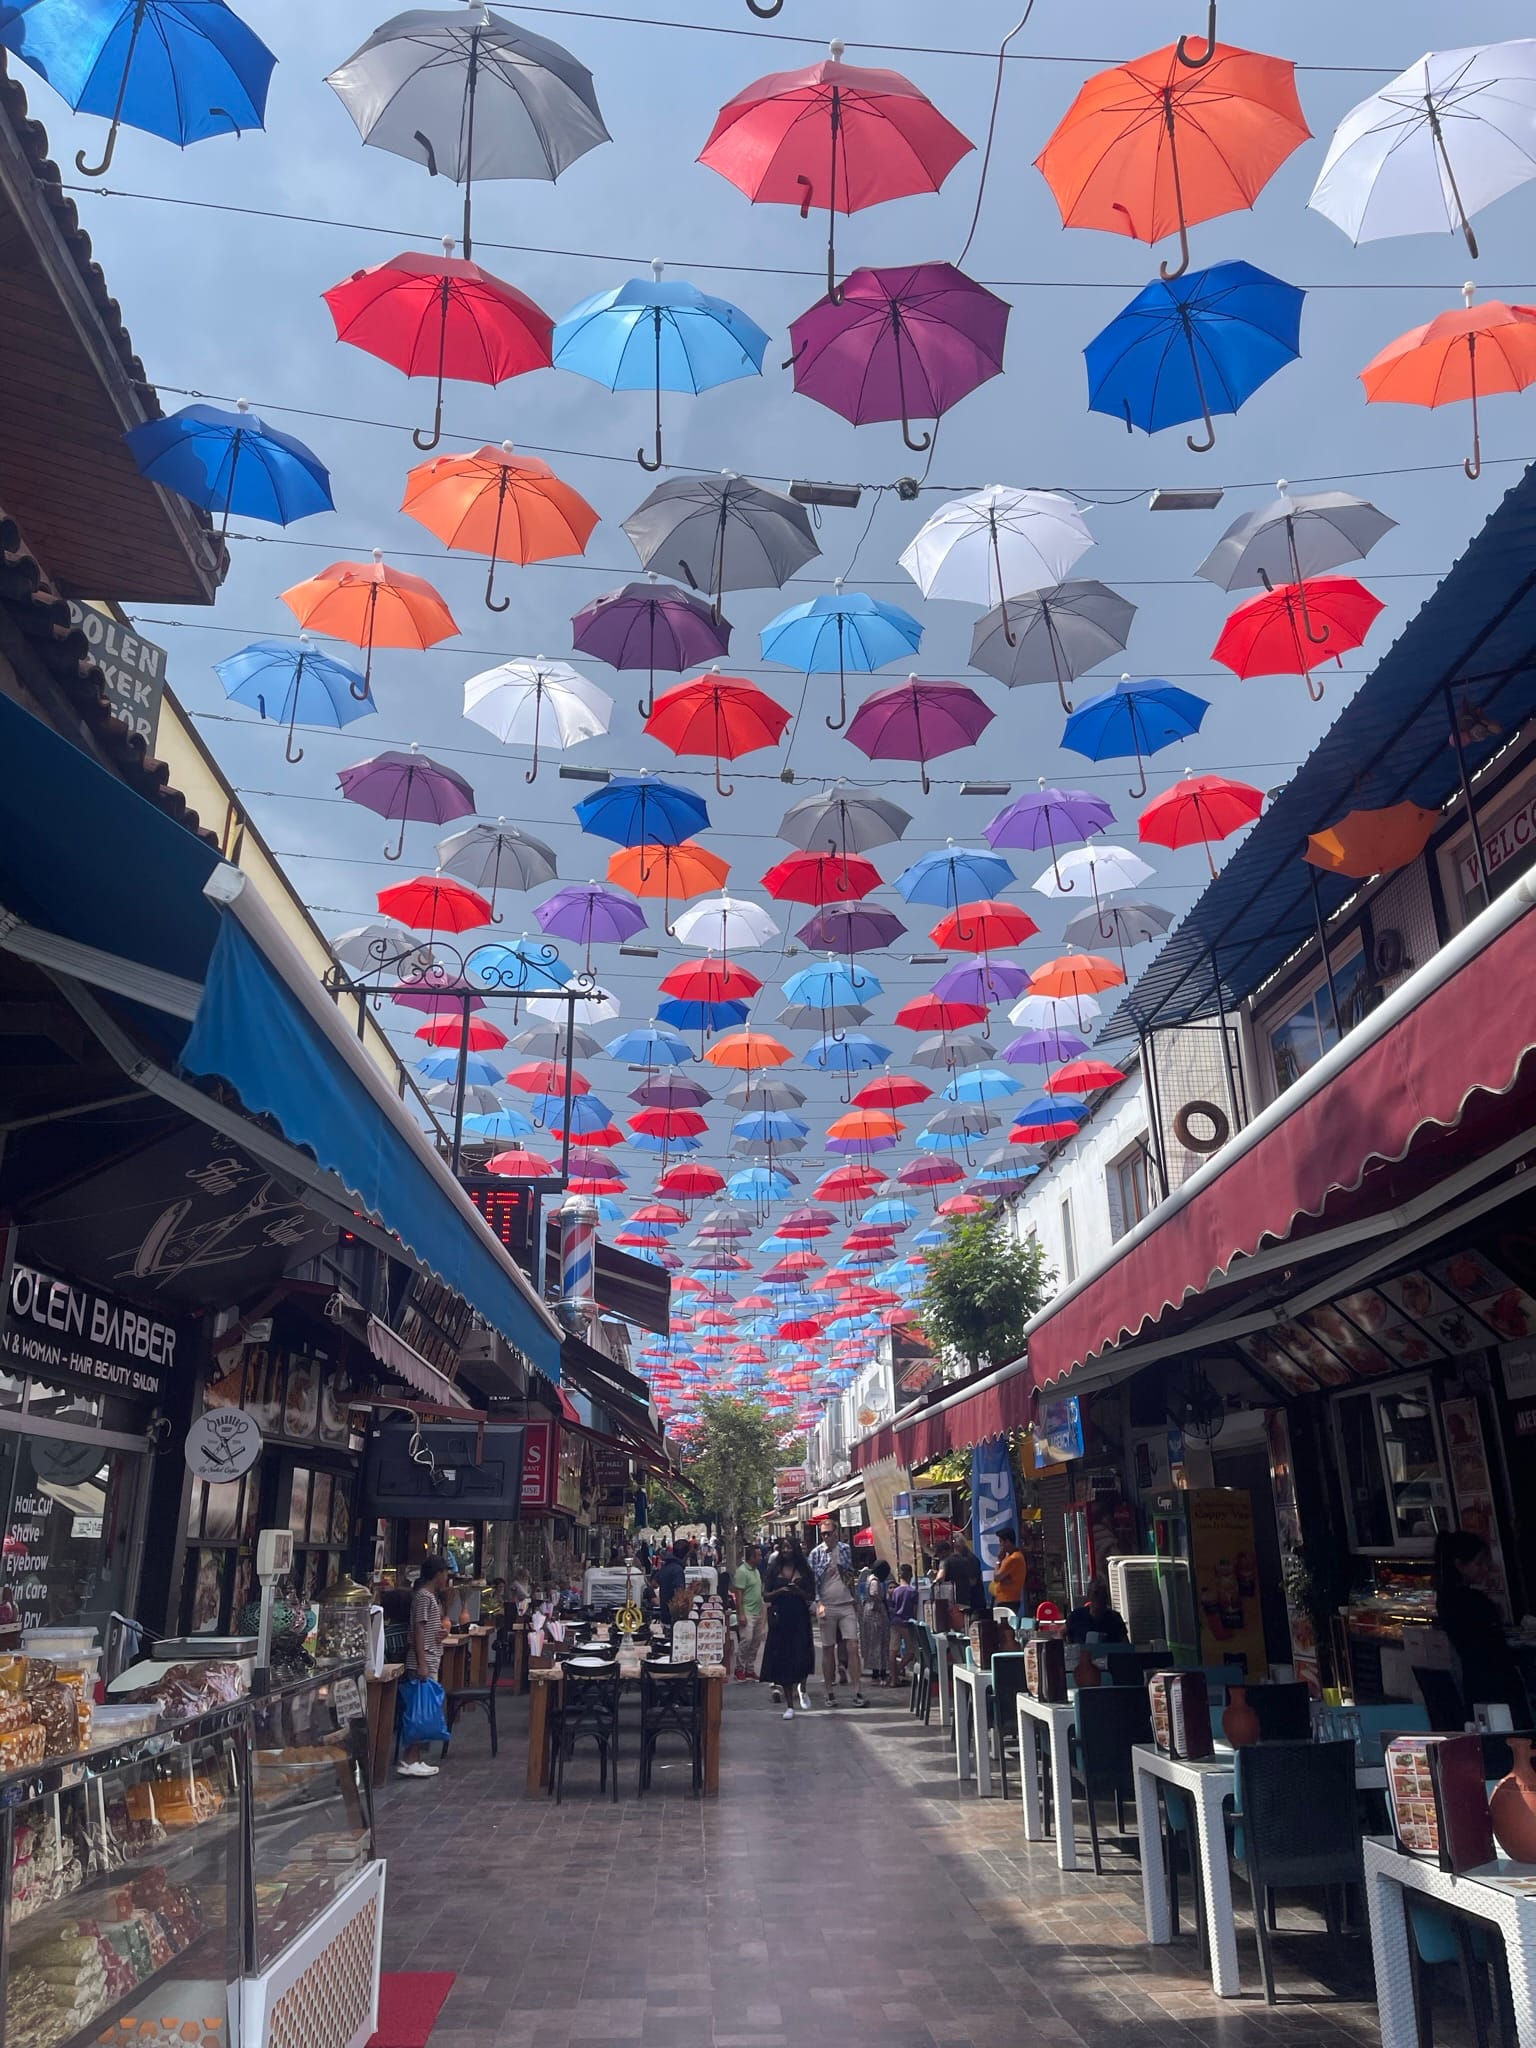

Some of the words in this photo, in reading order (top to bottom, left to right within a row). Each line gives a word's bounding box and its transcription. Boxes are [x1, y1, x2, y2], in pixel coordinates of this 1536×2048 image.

[88, 652, 152, 708] KEK
[10, 1267, 87, 1337] OLEN
[90, 1297, 177, 1368] BARBER
[12, 1333, 20, 1354] &
[22, 1336, 62, 1366] WOMAN
[69, 1352, 93, 1376] HAIR
[94, 1360, 132, 1386] BEAUTY
[132, 1371, 160, 1393] SALON
[15, 1494, 34, 1513] Hair
[11, 1524, 40, 1543] Shave
[6, 1554, 49, 1577] Eyebrow
[25, 1582, 48, 1600] Care
